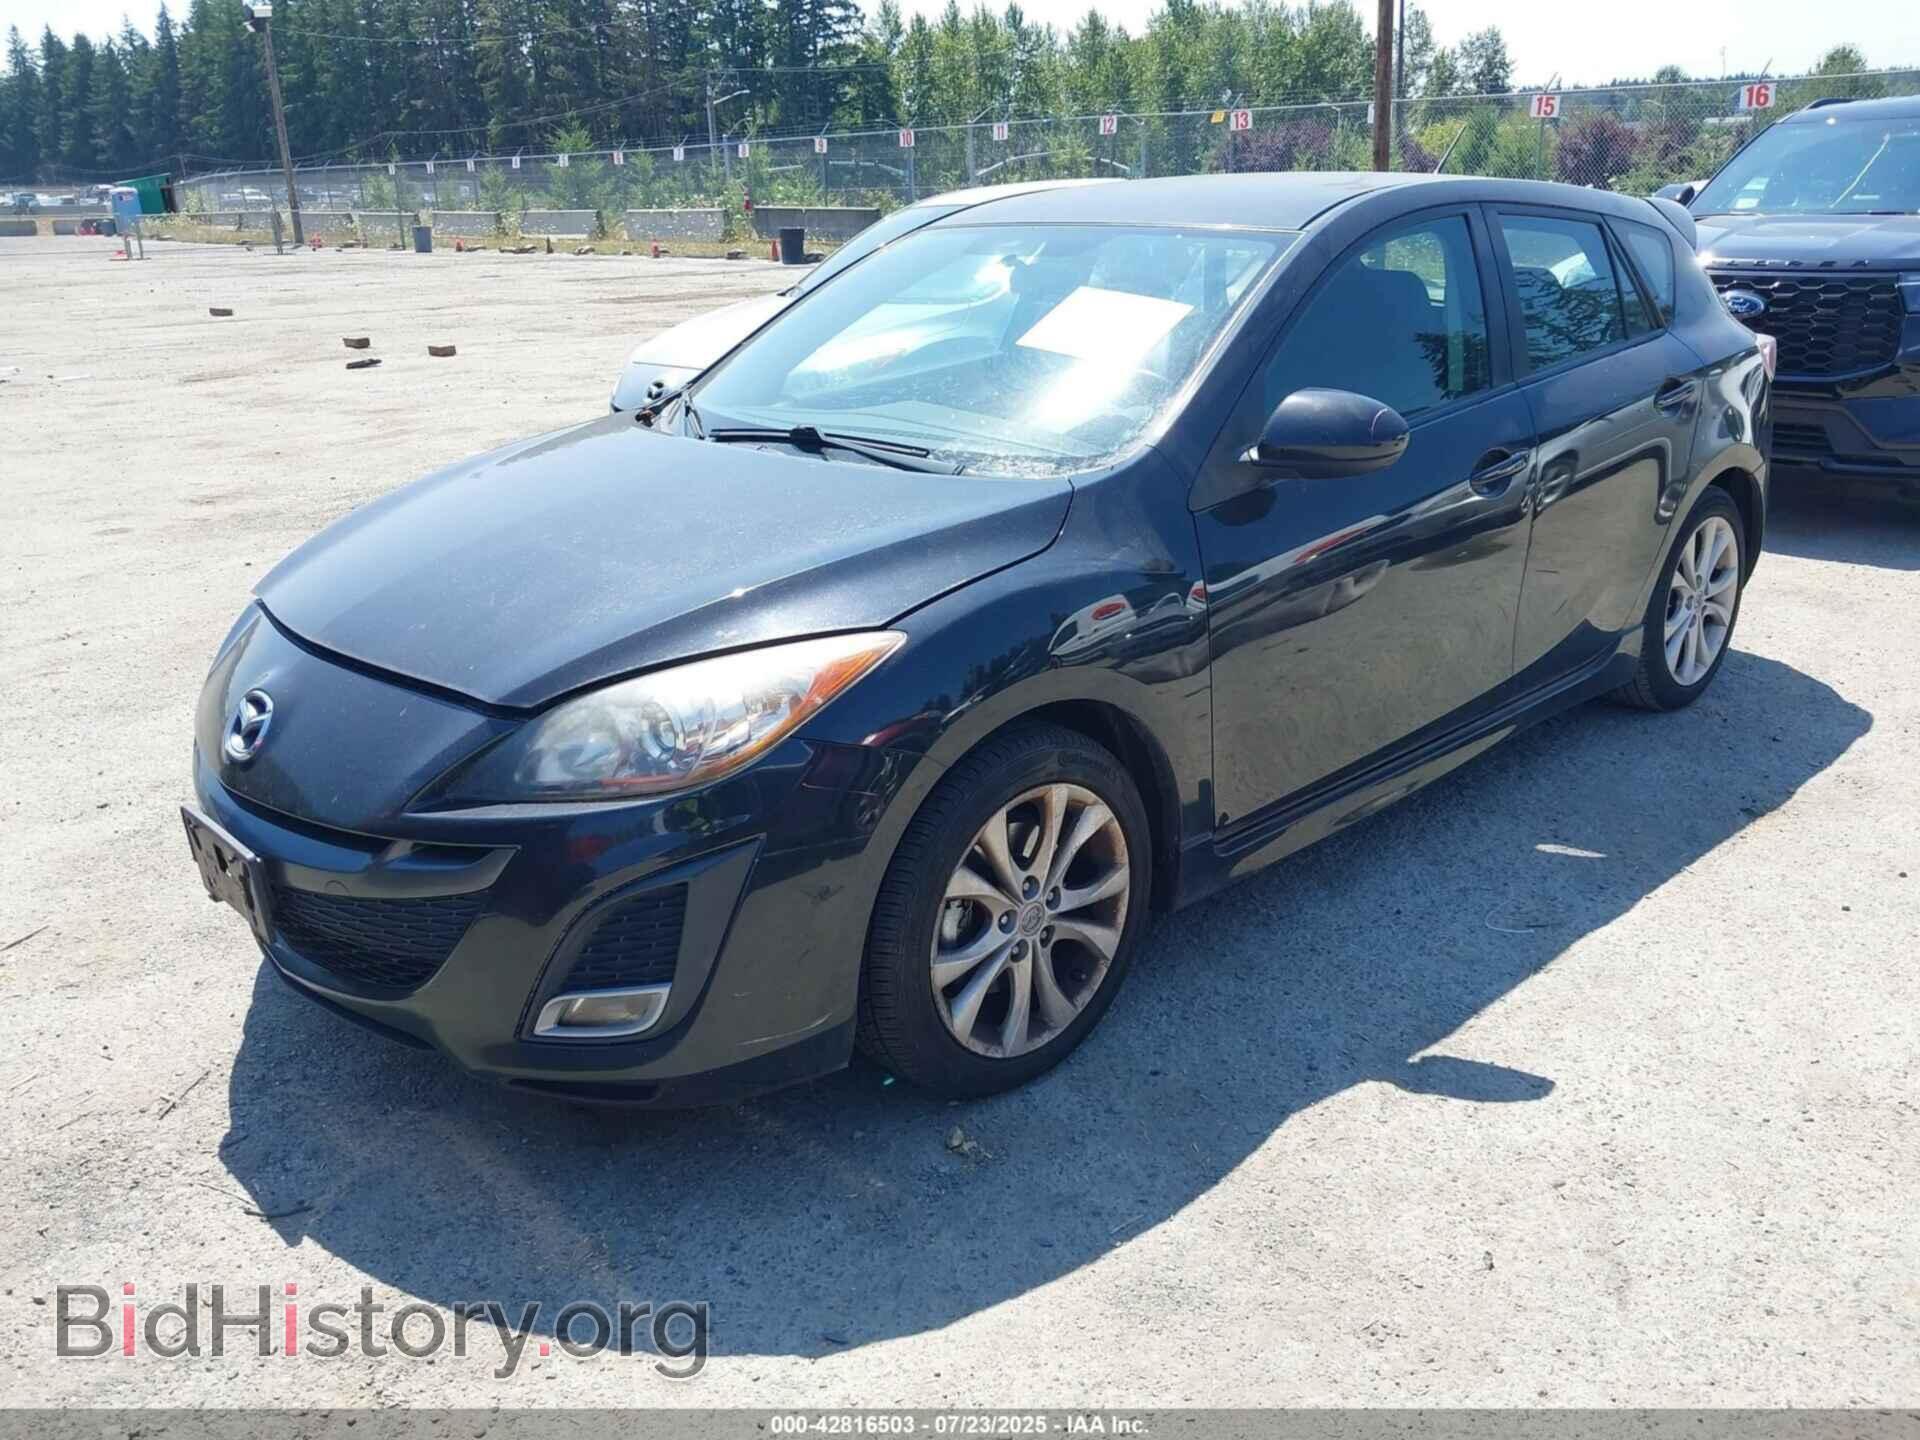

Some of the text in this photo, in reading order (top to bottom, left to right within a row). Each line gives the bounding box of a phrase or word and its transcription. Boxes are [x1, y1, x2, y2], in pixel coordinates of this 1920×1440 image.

[1746, 84, 1769, 108] 16
[1534, 95, 1555, 116] 15
[1103, 116, 1115, 133] 12
[1234, 111, 1249, 129] 13
[902, 131, 913, 147] 10
